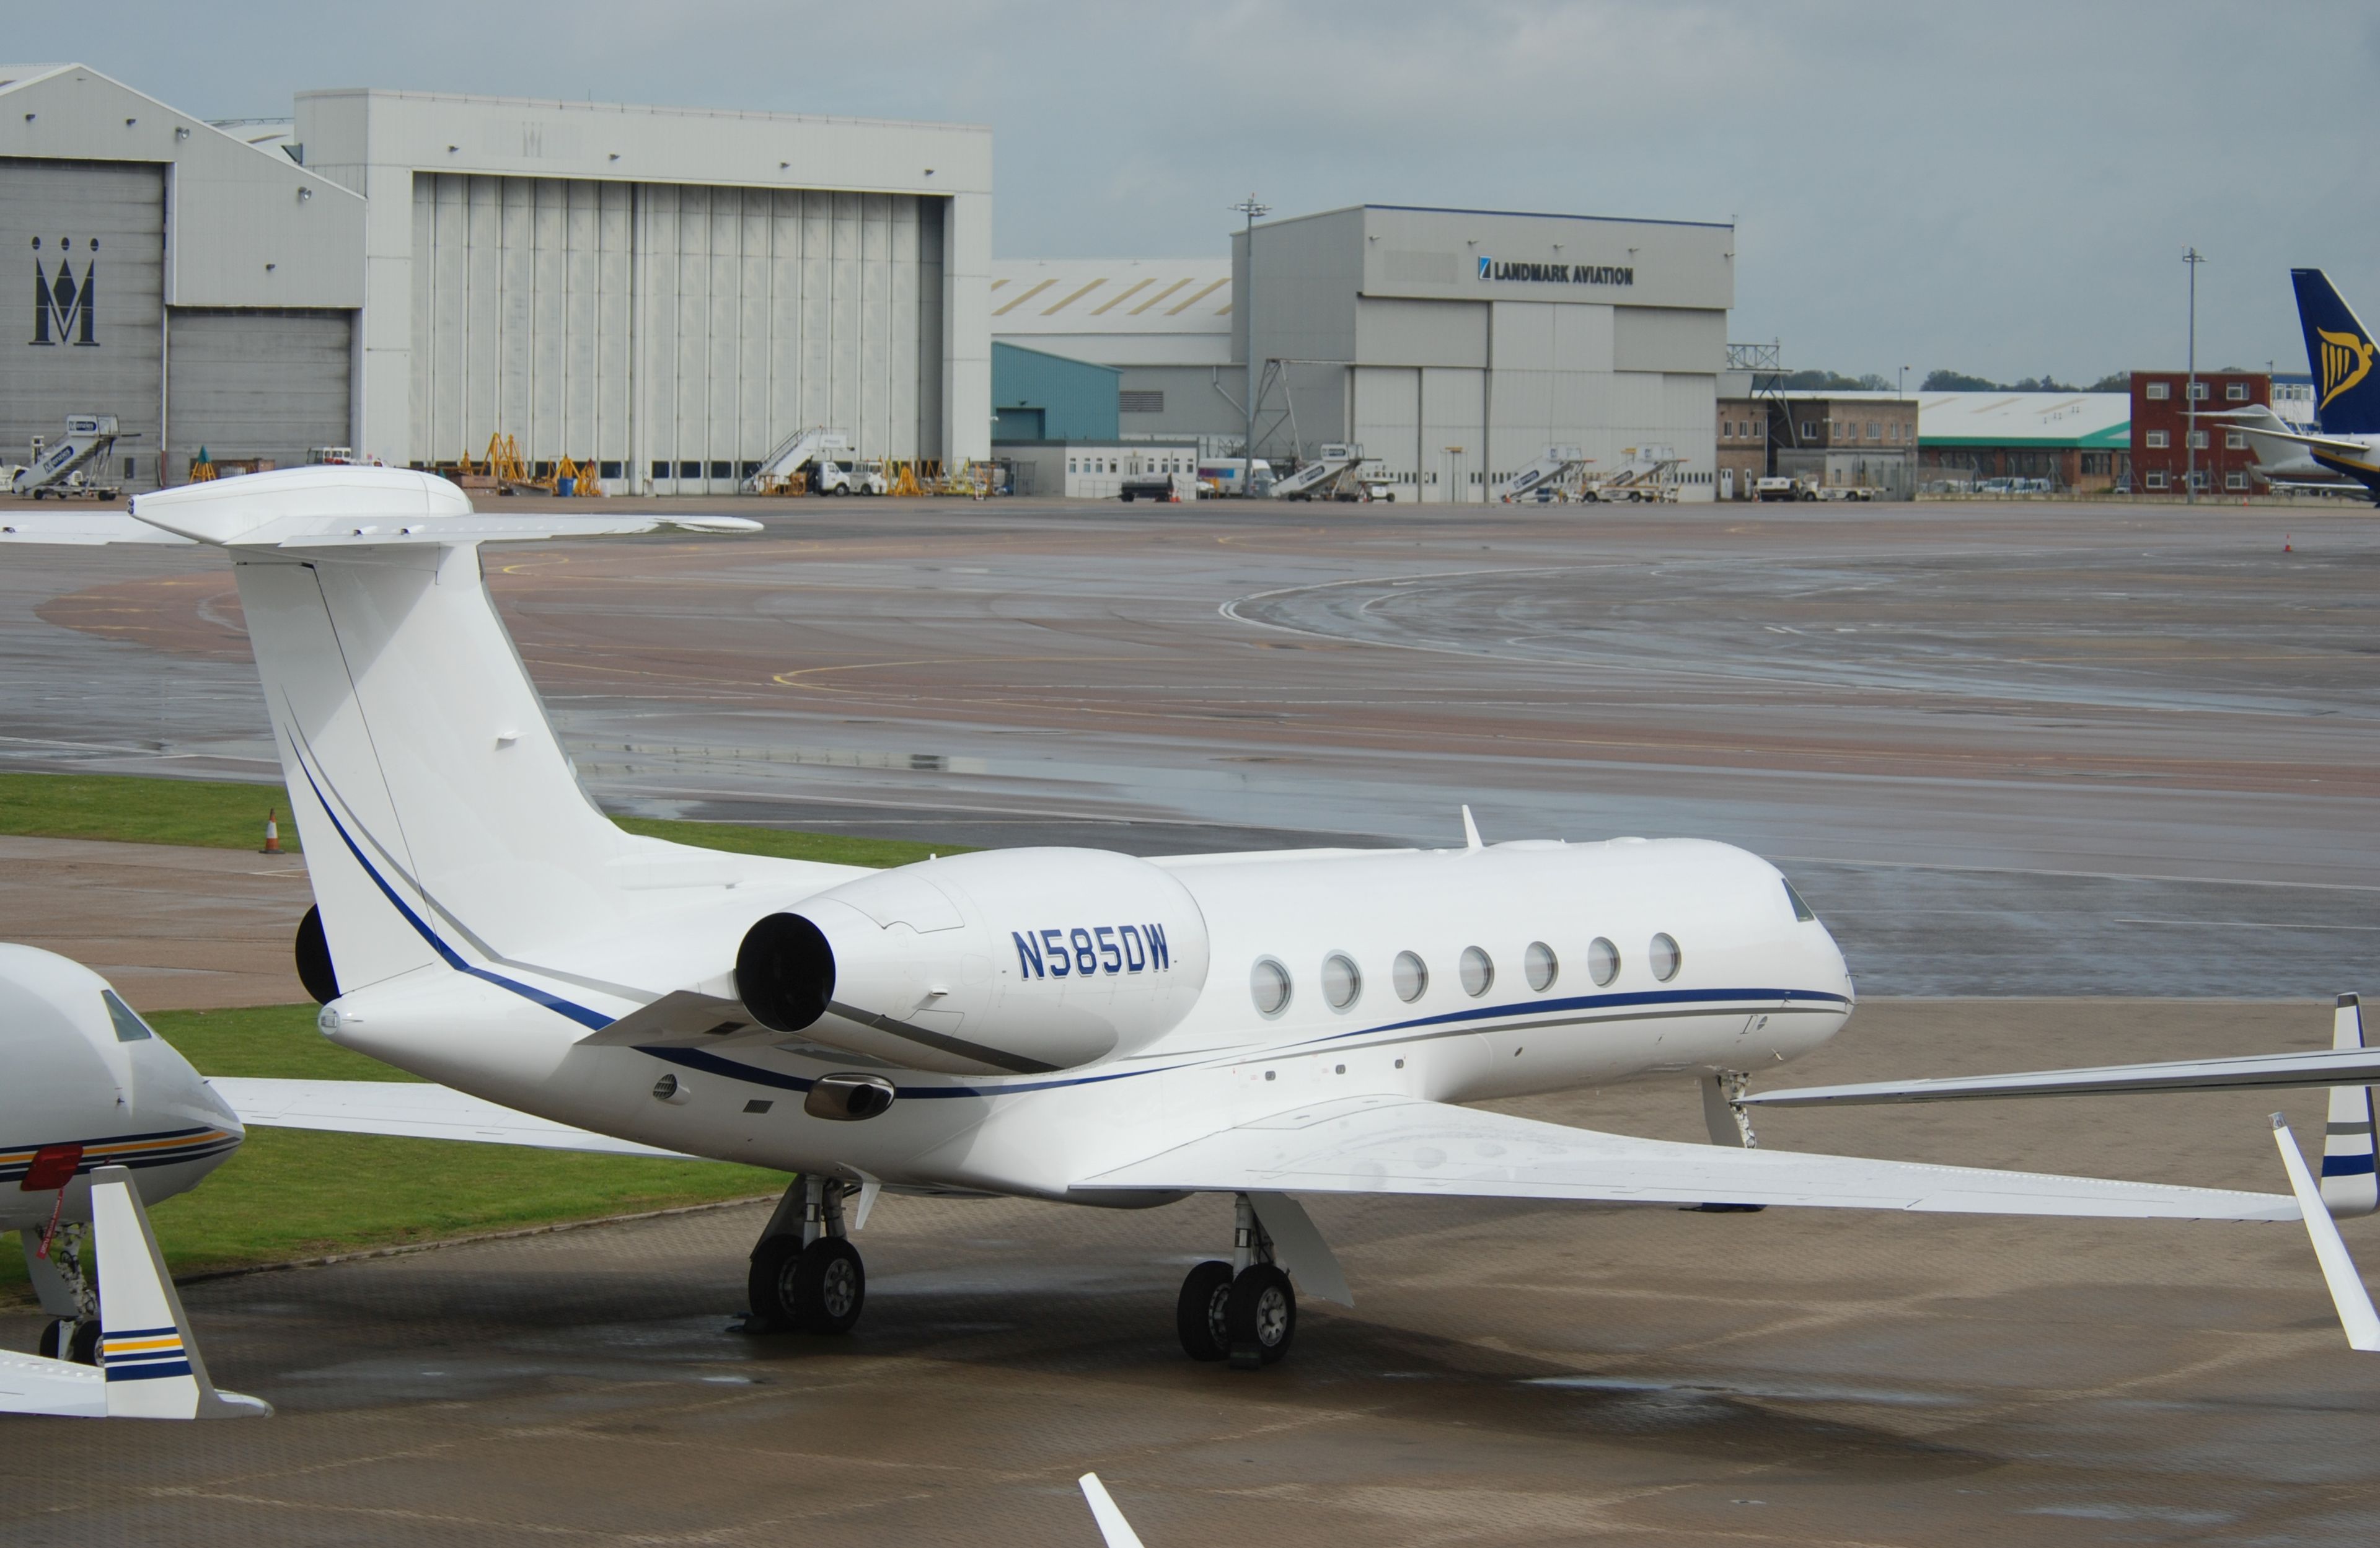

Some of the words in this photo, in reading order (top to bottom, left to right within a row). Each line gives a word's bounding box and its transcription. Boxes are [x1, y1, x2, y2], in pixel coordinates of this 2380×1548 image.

[1494, 262, 1570, 283] LANDMARK
[1573, 265, 1634, 285] AVIATION
[1011, 923, 1169, 980] N585DW
